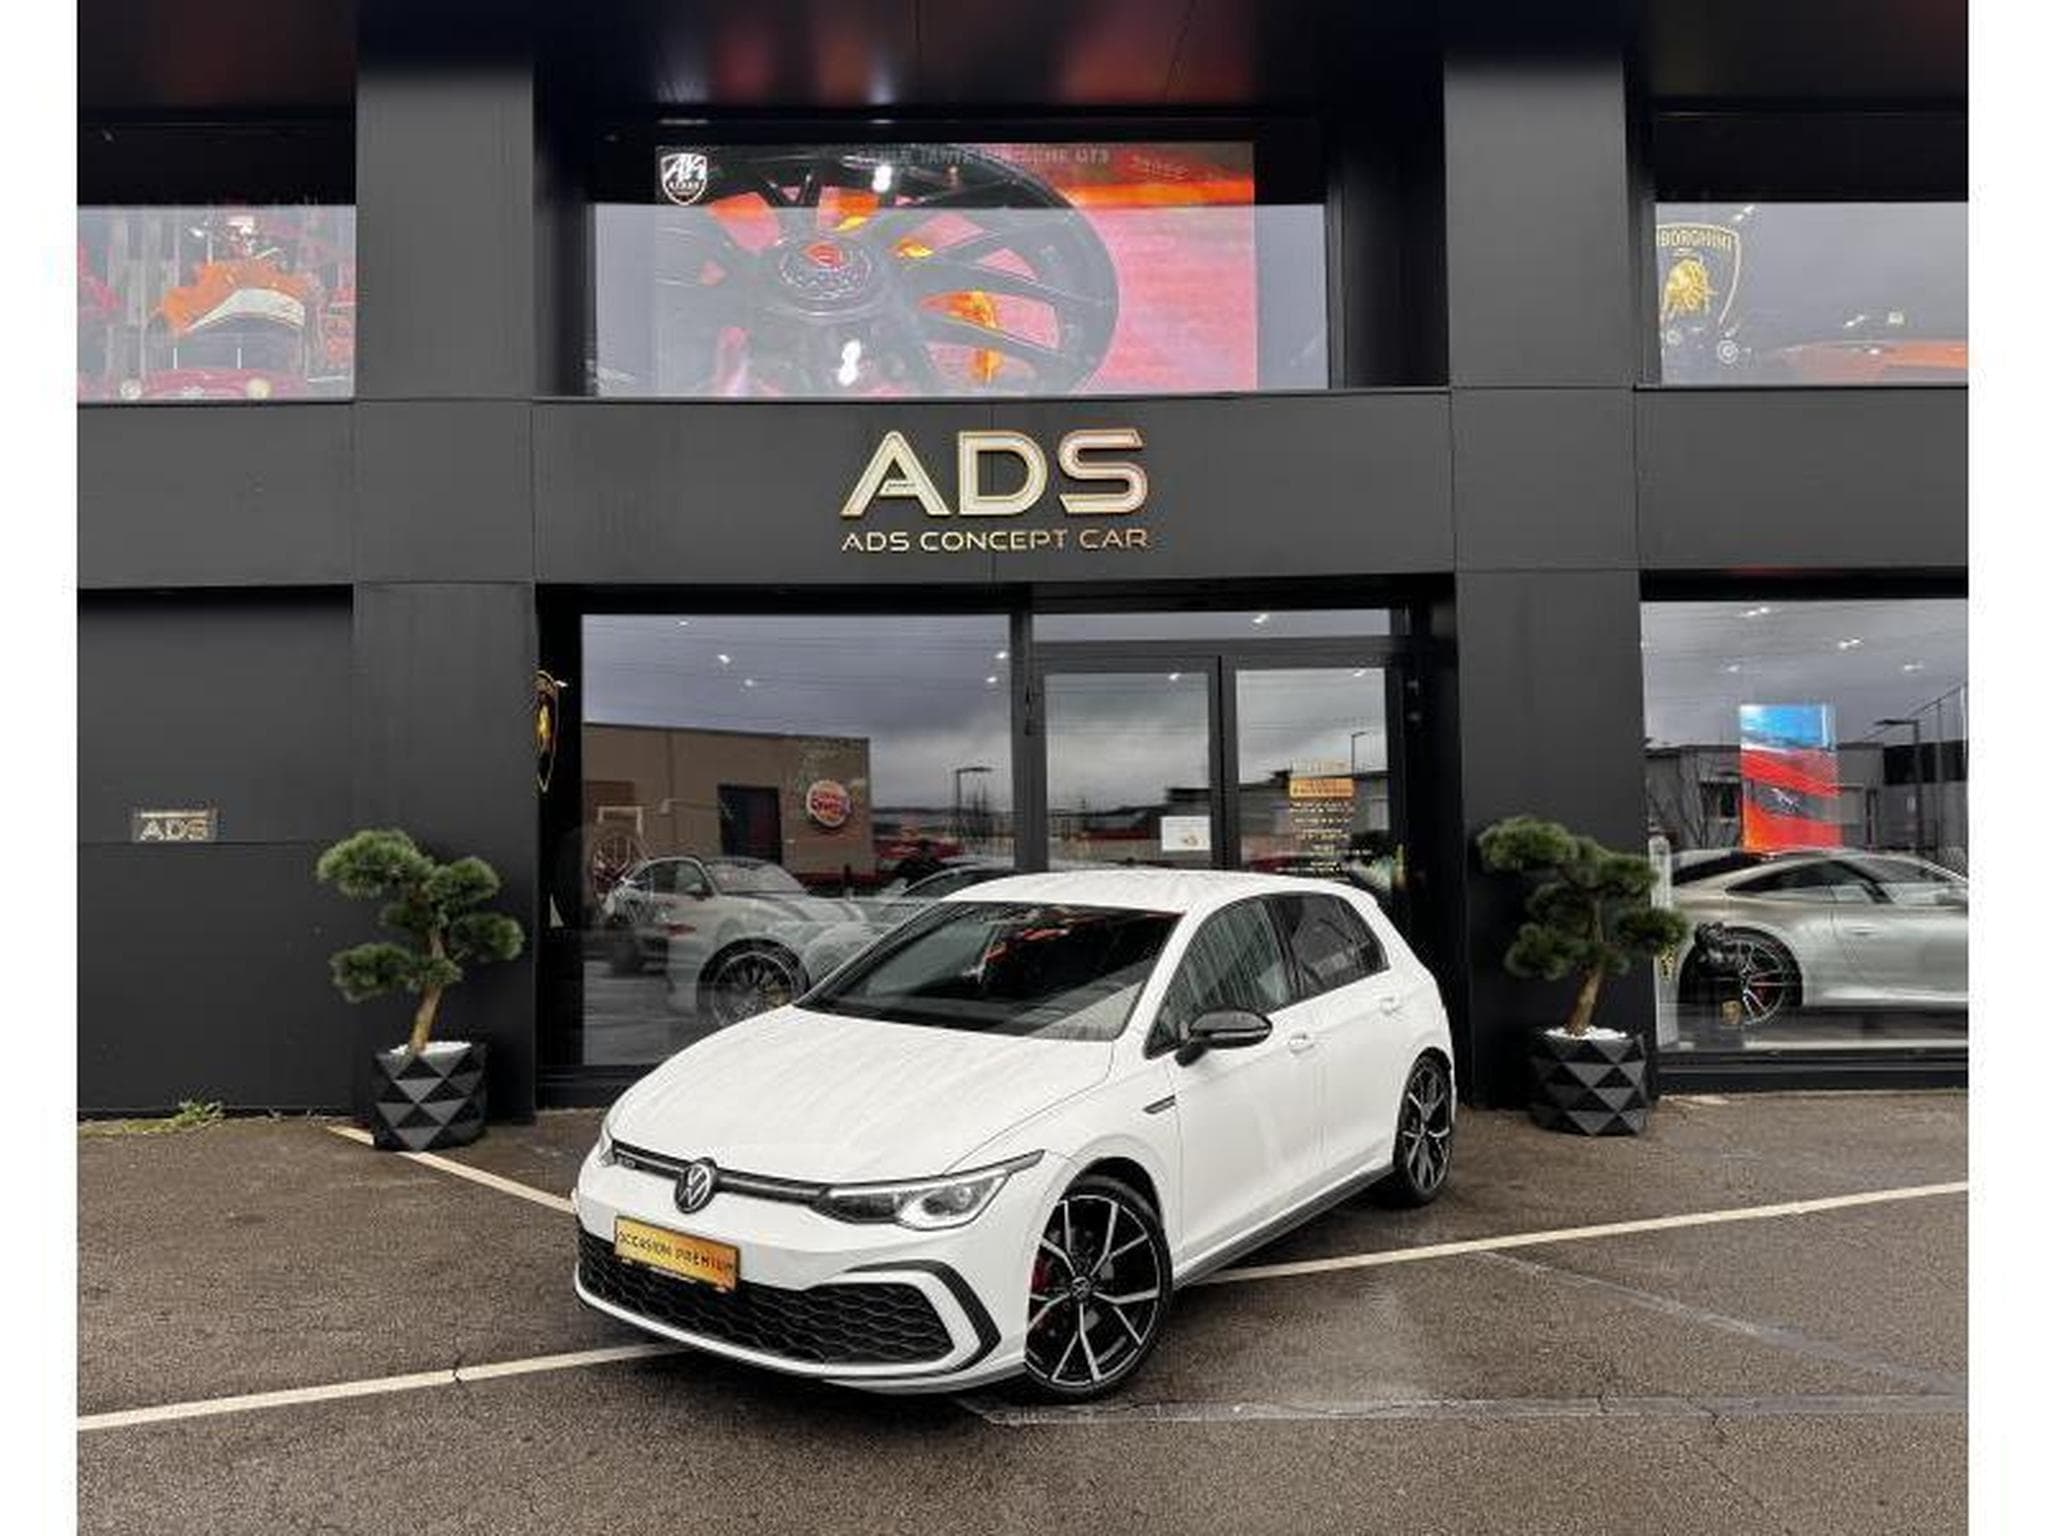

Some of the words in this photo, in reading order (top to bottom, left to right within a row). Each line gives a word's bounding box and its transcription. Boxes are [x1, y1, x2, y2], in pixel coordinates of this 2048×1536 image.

[841, 428, 1149, 517] ADS
[841, 530, 911, 552] ADS
[919, 528, 1068, 552] CONCEPT
[1078, 527, 1150, 550] CAR
[140, 818, 209, 841] ADS
[617, 1231, 672, 1256] OCCASION
[675, 1247, 733, 1272] PREMIUM
